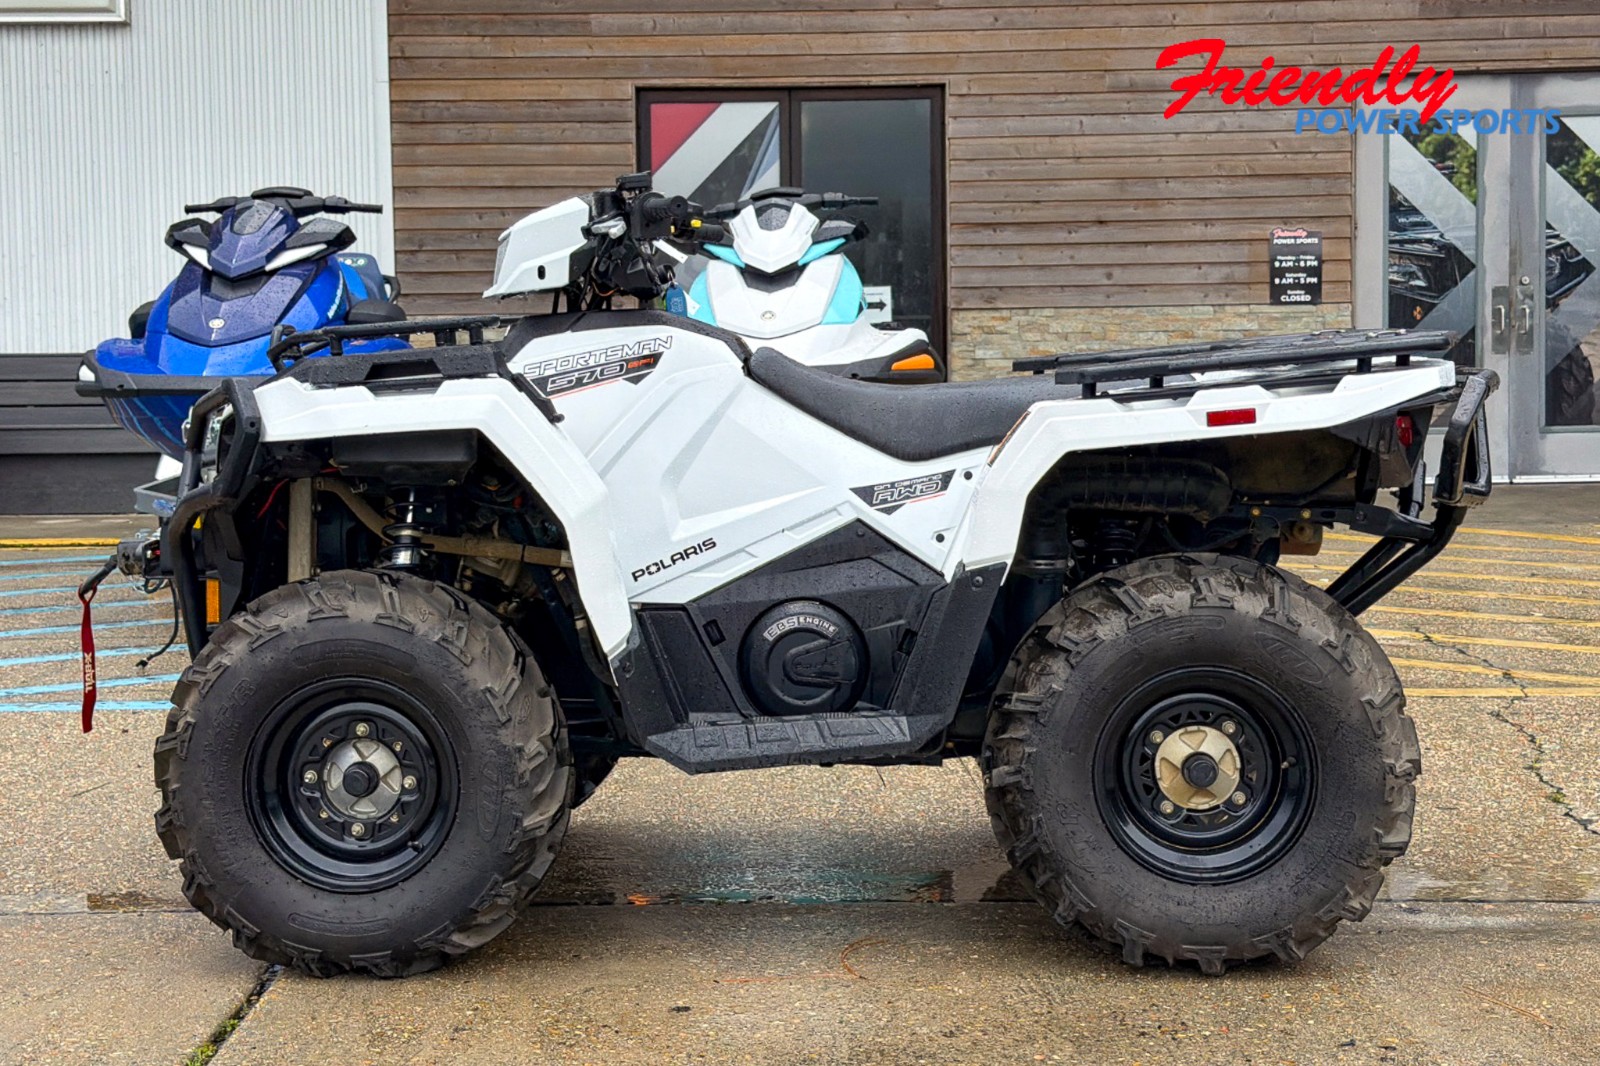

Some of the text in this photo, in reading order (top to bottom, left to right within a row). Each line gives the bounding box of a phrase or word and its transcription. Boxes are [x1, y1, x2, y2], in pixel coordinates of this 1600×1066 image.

[1300, 277, 1305, 285] 5
[523, 335, 673, 376] SPORTSMAN
[547, 361, 627, 392] 570
[872, 480, 942, 505] AWD
[631, 537, 717, 582] POLARIS
[766, 616, 836, 639] EBS ENGINE
